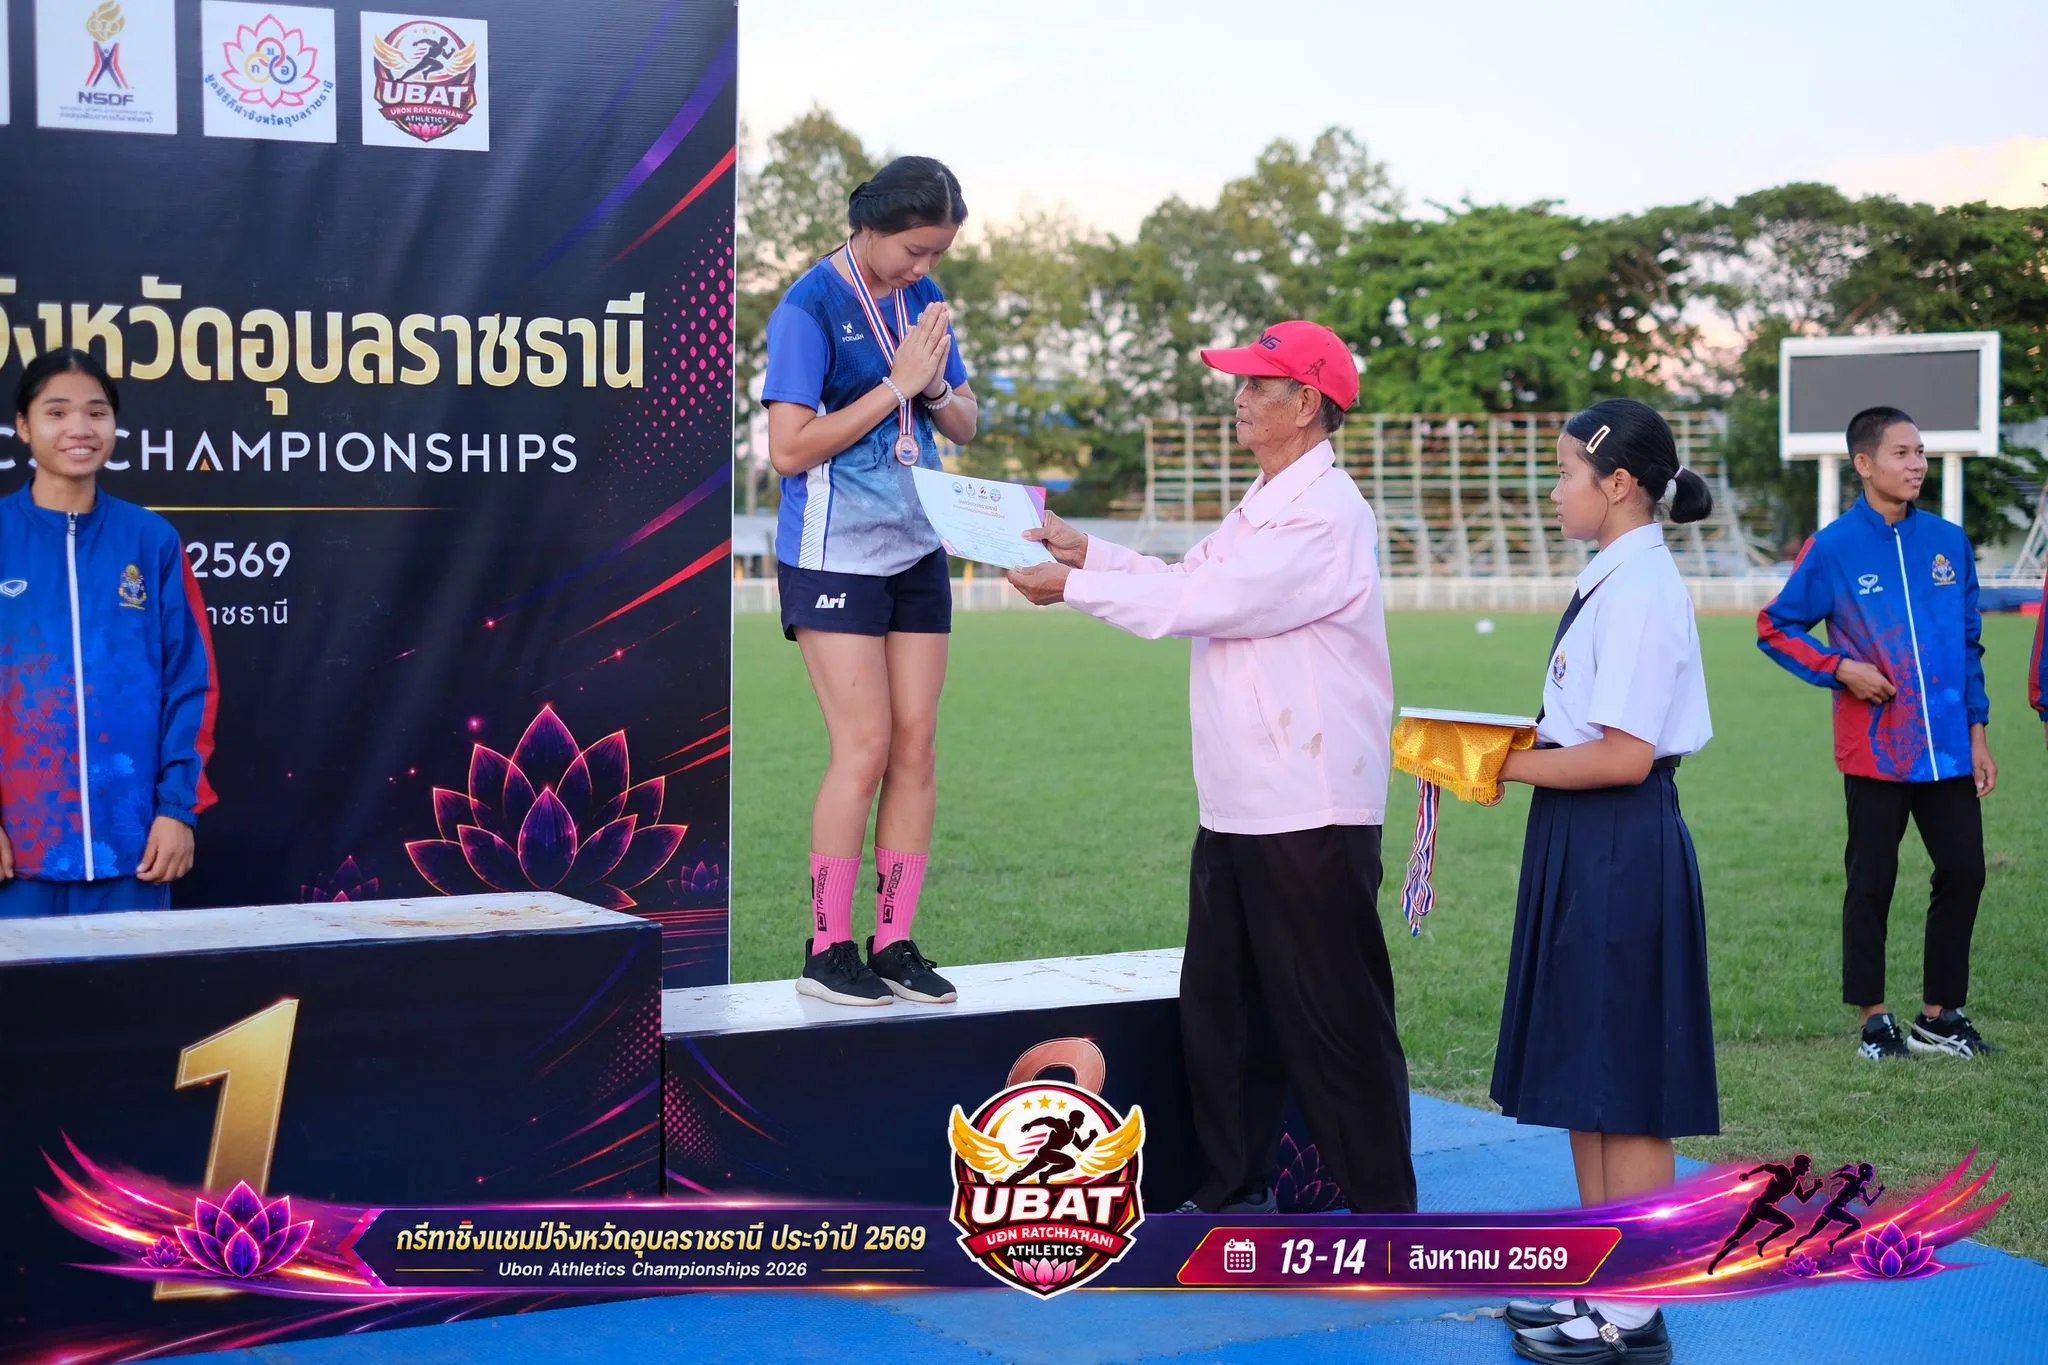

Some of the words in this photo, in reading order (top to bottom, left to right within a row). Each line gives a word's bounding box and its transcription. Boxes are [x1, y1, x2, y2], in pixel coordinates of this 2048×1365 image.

[78, 91, 134, 106] NSDF
[383, 80, 468, 108] UBAT
[390, 107, 412, 116] UBON
[413, 106, 464, 120] RATCHATHANI
[405, 115, 448, 124] ATHLETICS
[185, 541, 291, 578] 2569
[815, 592, 847, 609] Ari
[816, 865, 829, 910] TAPEDESIGN
